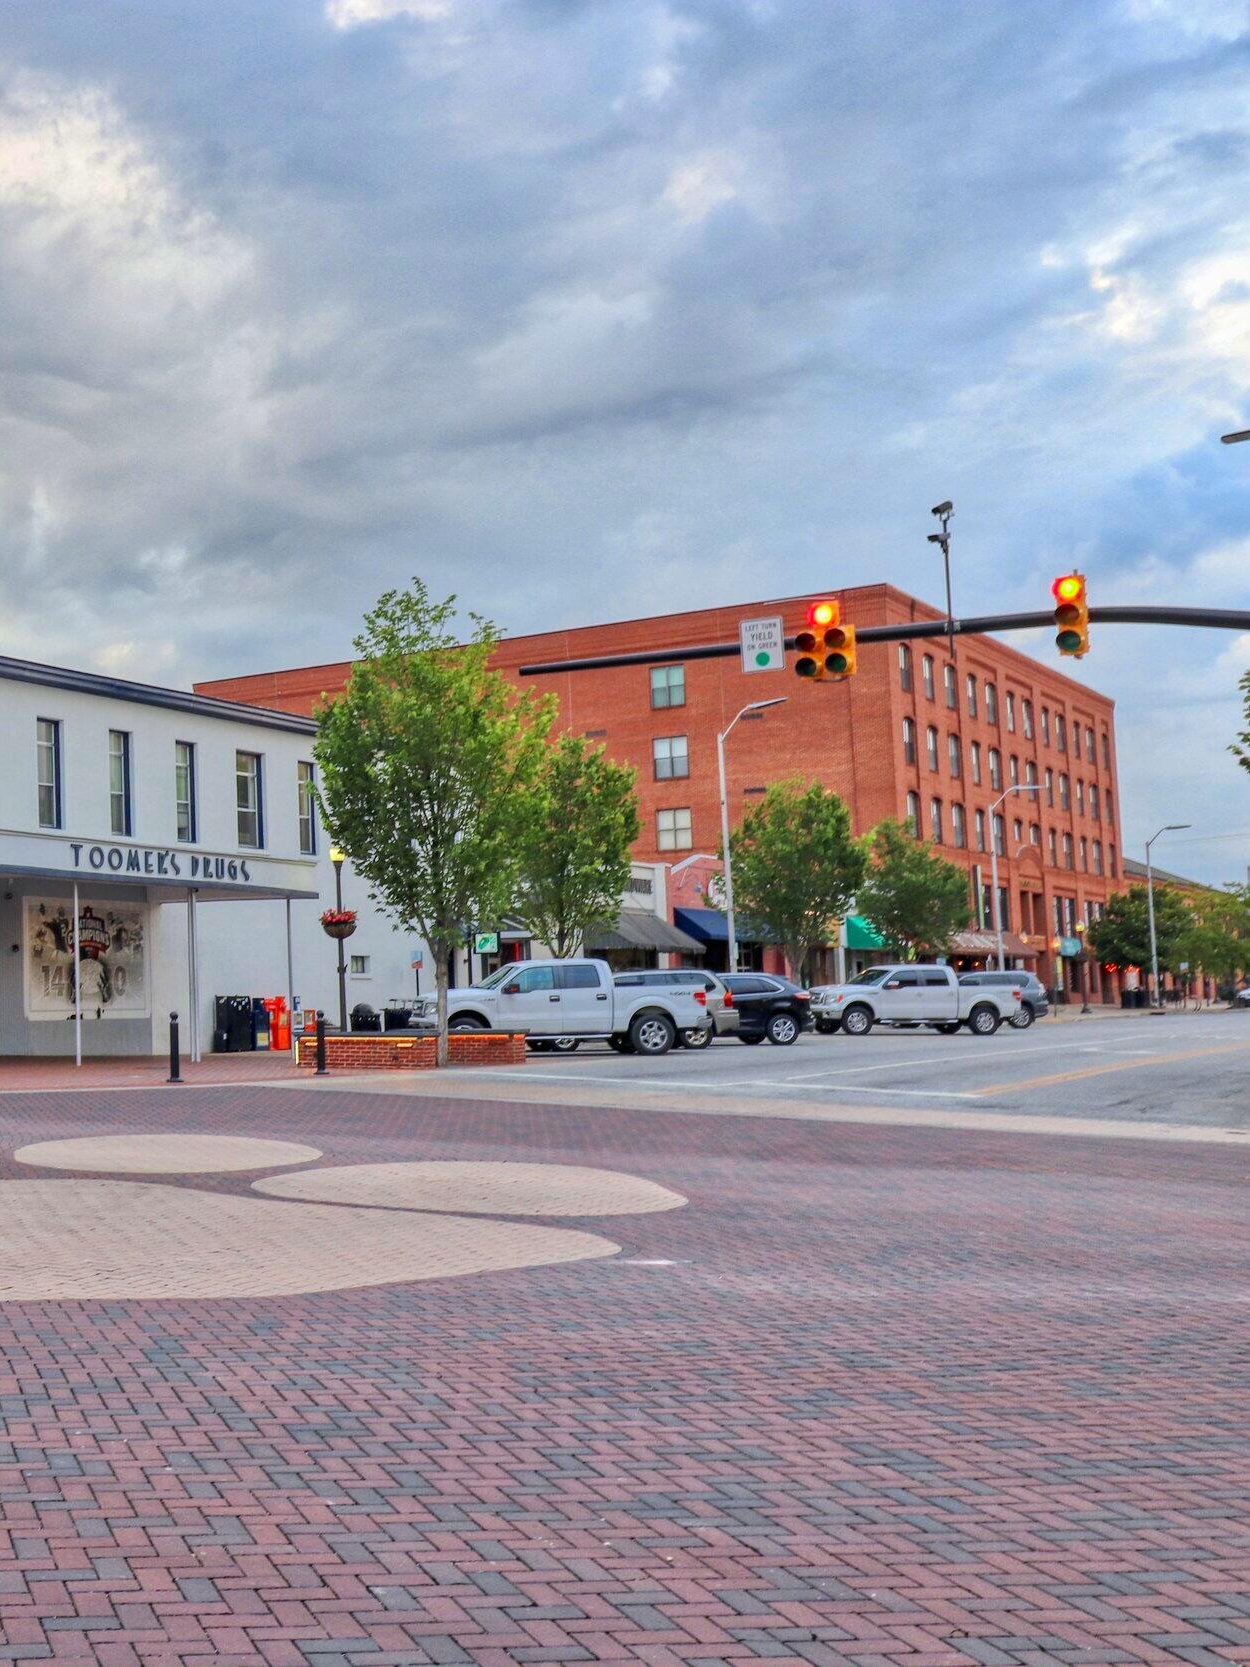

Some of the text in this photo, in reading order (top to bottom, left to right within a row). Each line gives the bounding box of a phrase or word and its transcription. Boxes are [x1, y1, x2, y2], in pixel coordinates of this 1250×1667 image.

[750, 631, 773, 642] YIELD
[70, 843, 251, 882] TOOMER'S DRUGS
